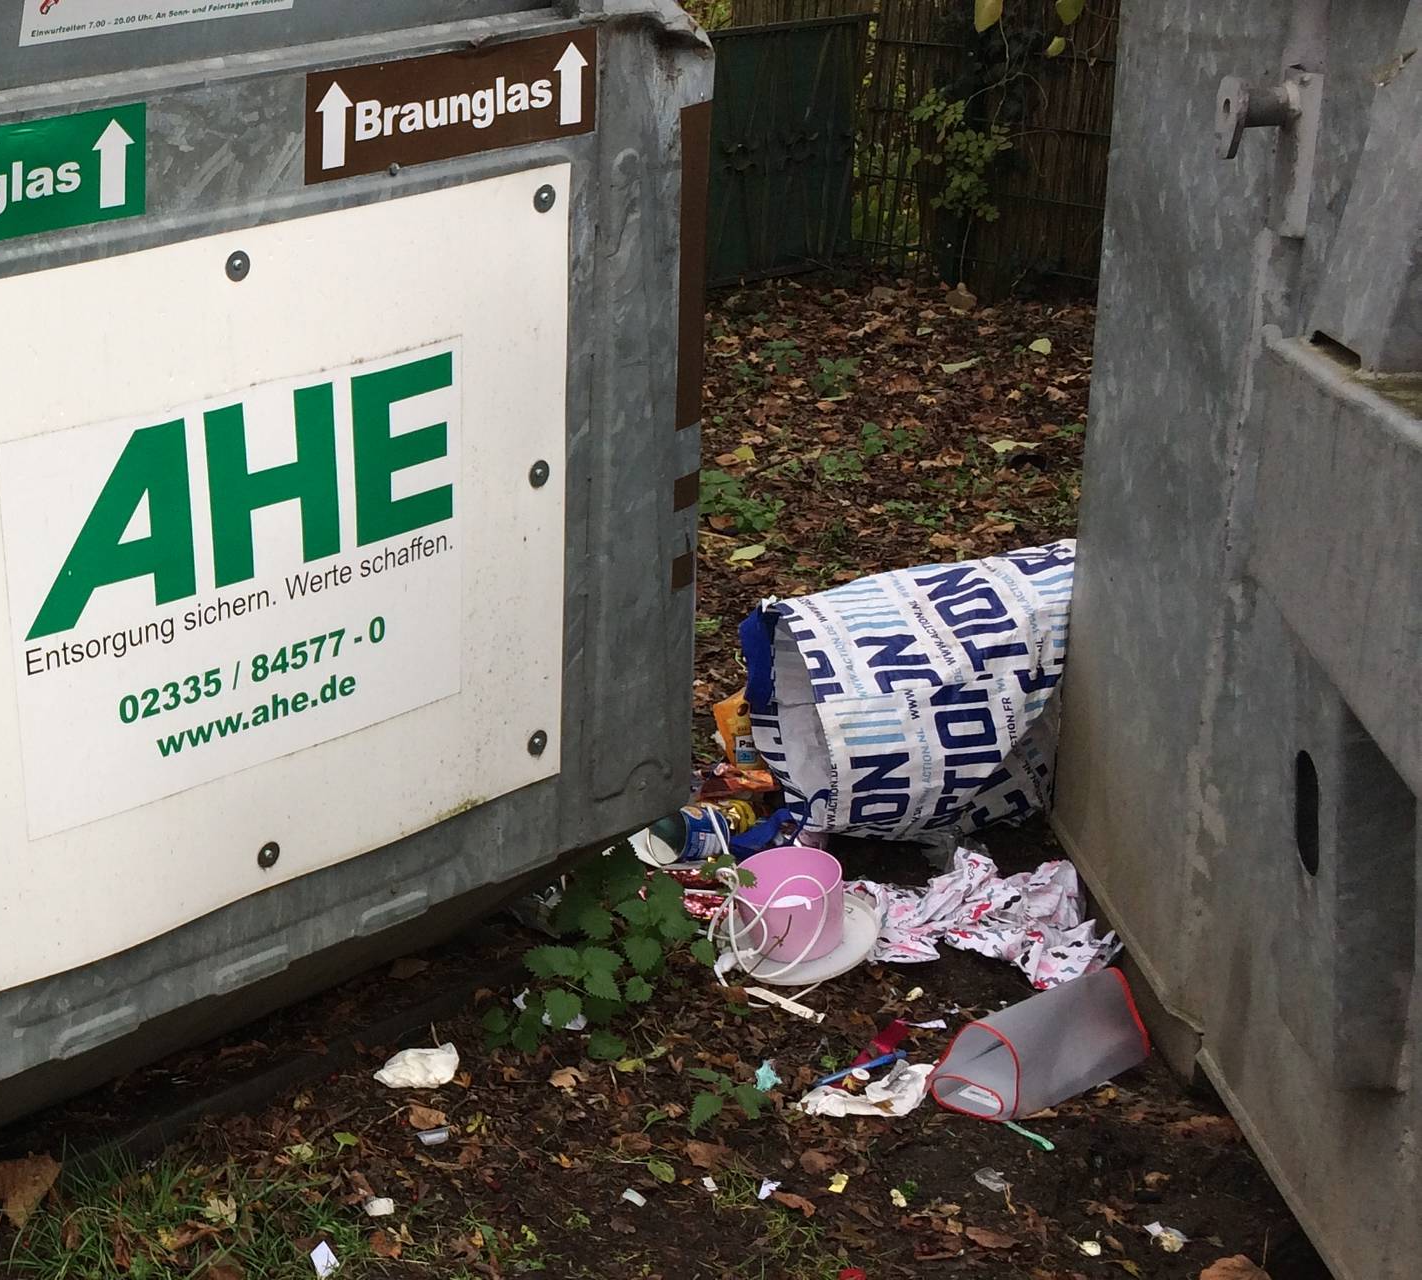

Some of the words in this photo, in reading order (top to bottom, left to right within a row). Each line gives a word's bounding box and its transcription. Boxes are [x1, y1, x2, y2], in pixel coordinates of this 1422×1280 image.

[30, 24, 86, 38] Einwurfzeiten
[114, 16, 136, 26] 20.00
[155, 11, 167, 20] An
[191, 5, 207, 14] und
[207, 1, 249, 13] Feiertagen
[355, 77, 553, 141] Braunglas
[25, 351, 453, 642] AHE
[26, 616, 175, 676] Entsorgung
[184, 589, 277, 632] sichern.
[285, 563, 352, 601] Werte
[360, 533, 454, 578] schaffen.
[119, 668, 223, 724] 02335
[232, 660, 241, 690] /
[251, 629, 346, 683] 84577
[369, 616, 386, 644] 0
[157, 673, 356, 757] www.ahe.de
